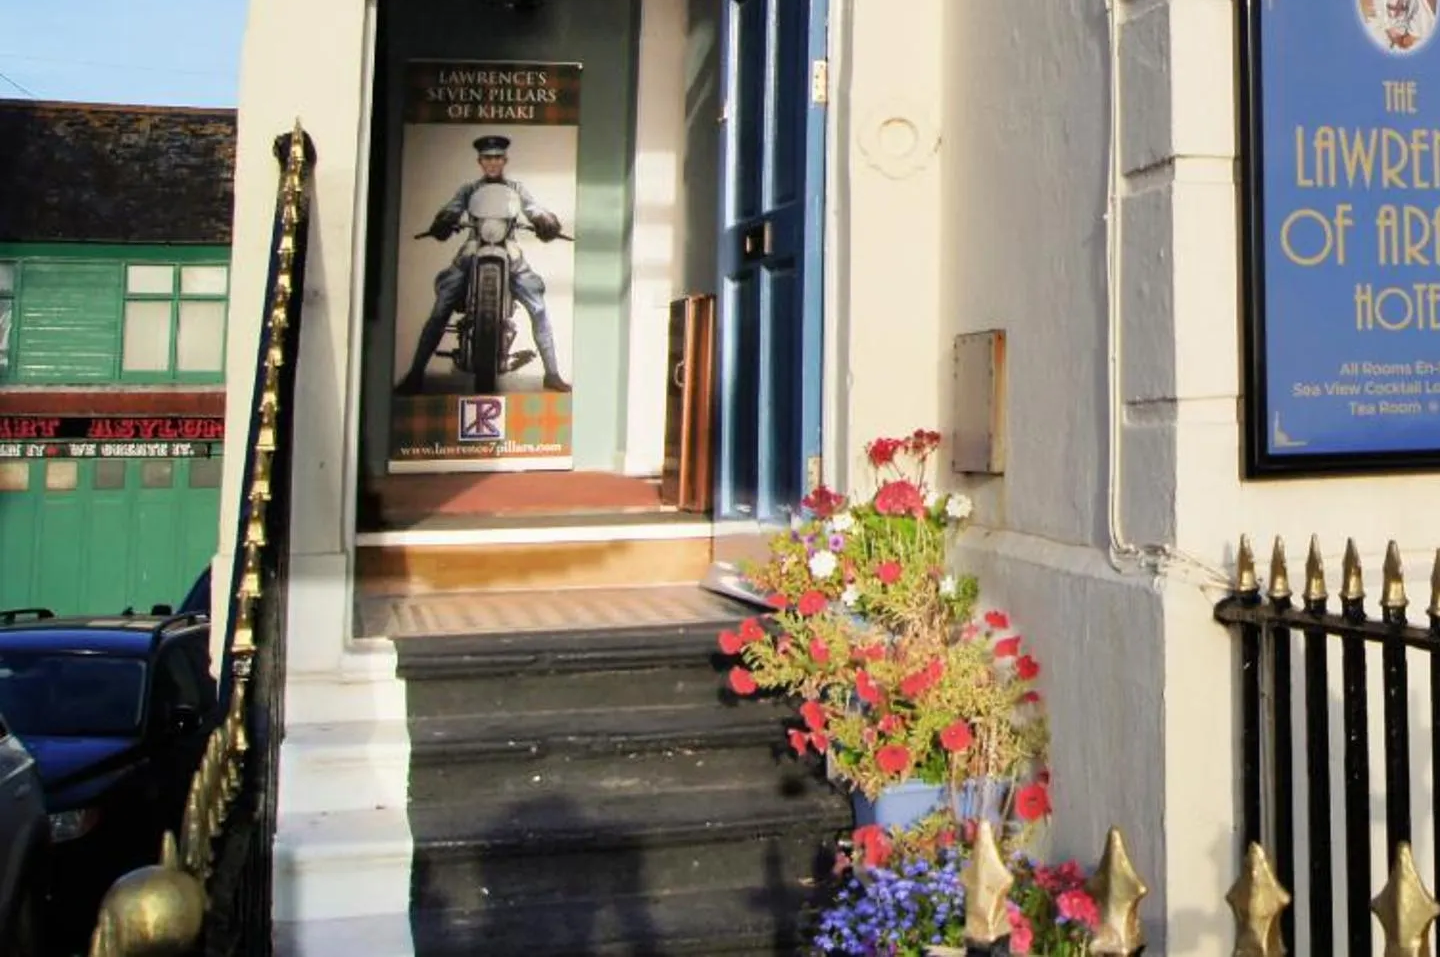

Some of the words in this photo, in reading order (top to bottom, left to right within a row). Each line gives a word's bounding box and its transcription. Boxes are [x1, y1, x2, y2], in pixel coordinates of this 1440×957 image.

[438, 69, 548, 85] LAWRENCE'S
[426, 87, 483, 102] SEVEN
[489, 88, 557, 103] PILLARS
[1381, 80, 1418, 114] THE
[446, 104, 473, 118] OF
[478, 104, 535, 119] KHAKI
[1280, 203, 1355, 267] OF
[1339, 363, 1358, 376] All
[1362, 362, 1412, 376] Rooms
[1292, 382, 1322, 397] Sea
[1324, 381, 1361, 396] View
[1364, 379, 1422, 395] Cocktail
[1349, 401, 1376, 416] Tea
[1379, 400, 1422, 415] Room
